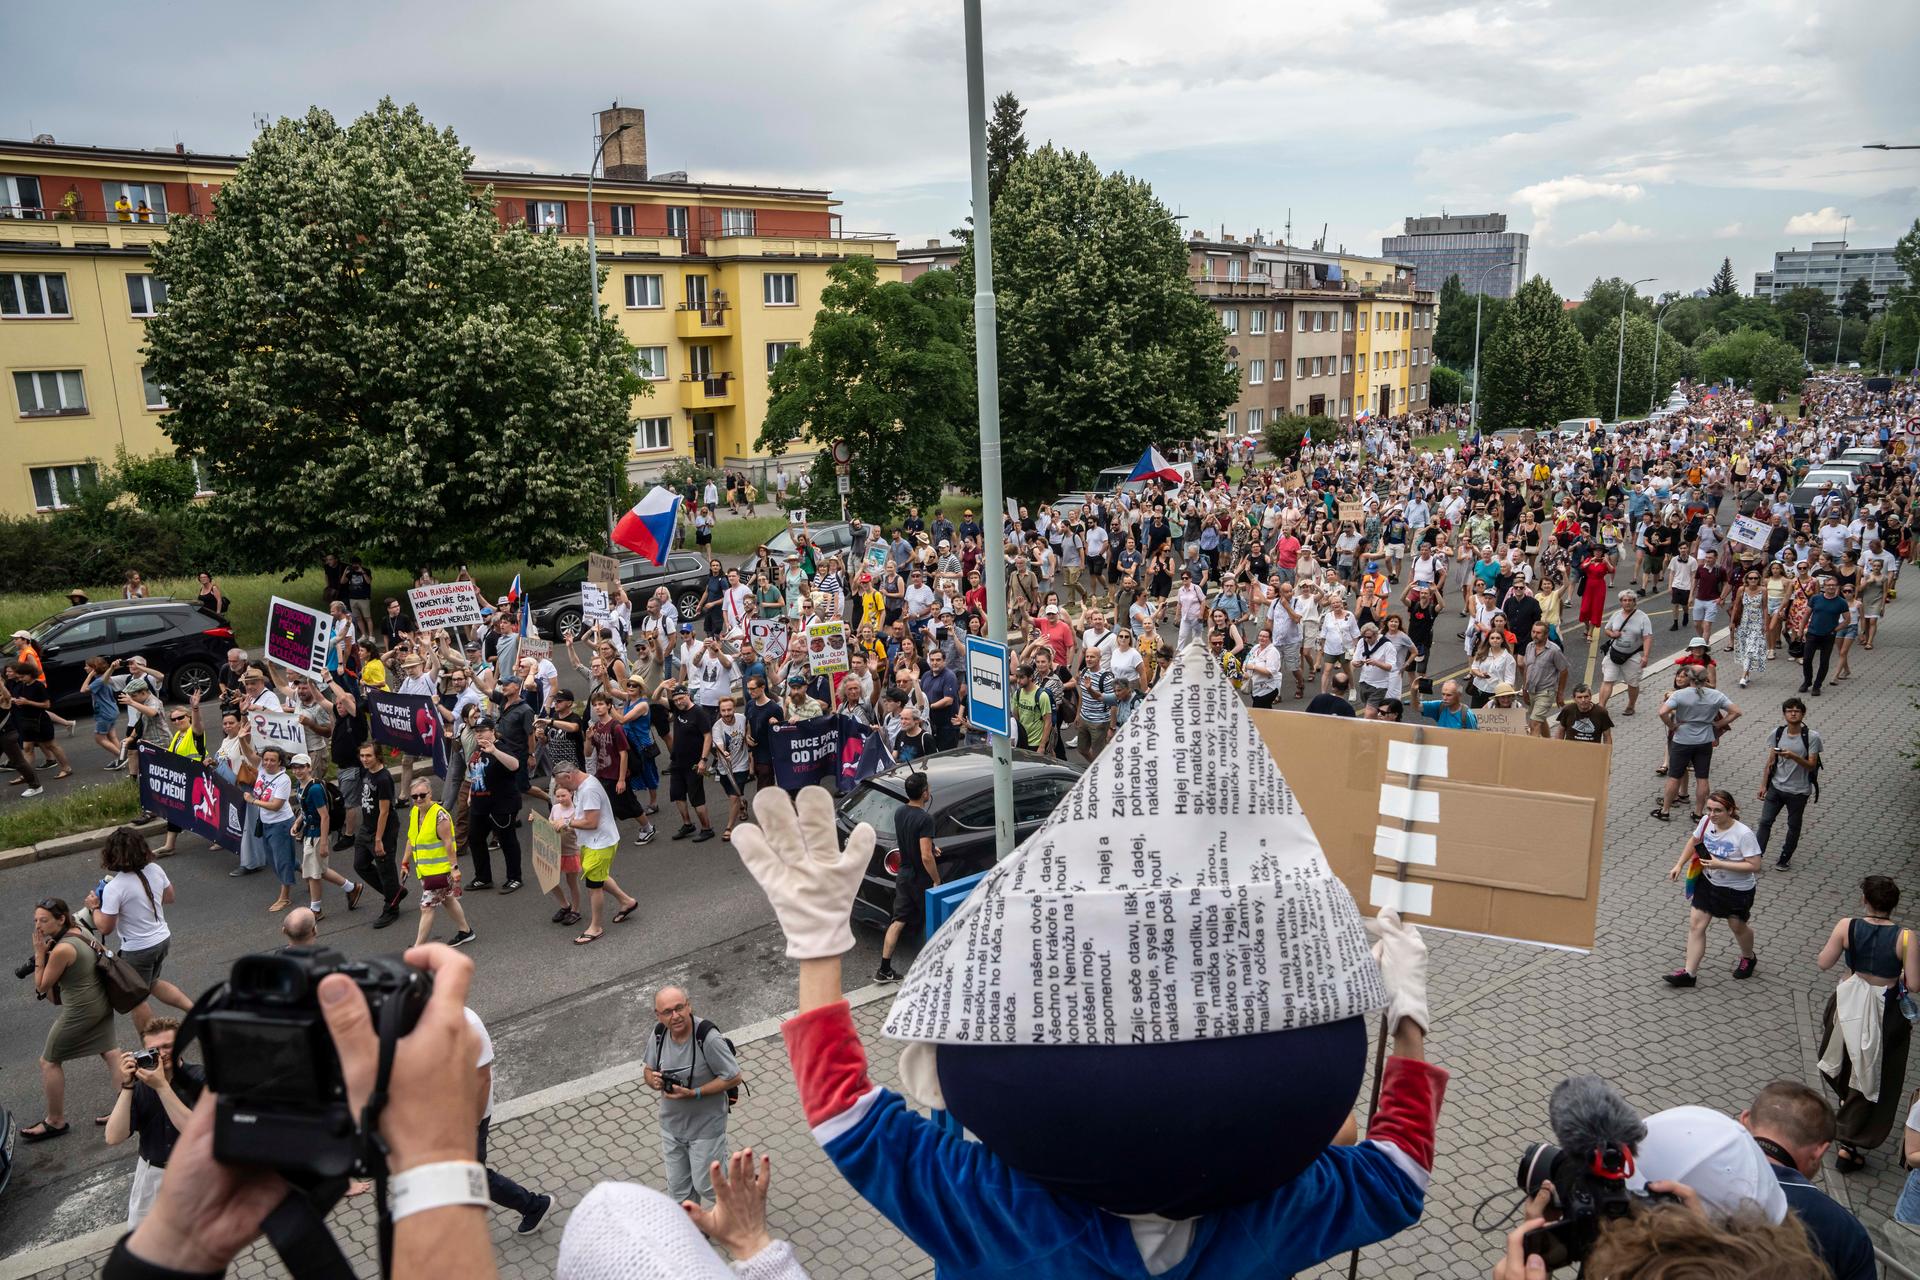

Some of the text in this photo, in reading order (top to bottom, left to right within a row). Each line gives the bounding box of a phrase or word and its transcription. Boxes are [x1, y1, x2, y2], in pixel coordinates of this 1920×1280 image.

[412, 590, 428, 600] LÍDA
[420, 616, 446, 628] PROSÍM
[268, 720, 302, 744] ZLÍN
[376, 702, 410, 718] RUCE PRYČ
[390, 716, 412, 732] MÉDIÍ
[790, 737, 819, 750] RUCE
[792, 750, 810, 764] OD
[1142, 706, 1160, 816] nakládá, myška
[1172, 690, 1189, 814] Hajej můj andílku,
[1188, 684, 1205, 814] spi, matička kolíbá
[1204, 684, 1216, 814] děťátko svý: Hajej,
[1228, 713, 1240, 814] maličký očíčka
[148, 764, 187, 786] RUCE PRYČ
[150, 778, 160, 792] OD
[162, 782, 186, 802] MÉDIÍ
[1112, 746, 1128, 818] Zajíc seče
[1128, 742, 1144, 816] pohrabuje,
[1218, 726, 1230, 815] dadej, malej!
[1246, 750, 1257, 814] Hajej můj
[1265, 764, 1276, 814] děťátko
[1258, 790, 1266, 814] spi,
[1040, 840, 1054, 883] dadej,
[1098, 836, 1113, 884] hajej a
[1130, 834, 1146, 878] dadej,
[1218, 831, 1228, 853] mu
[1030, 894, 1042, 934] dvoře
[1046, 907, 1058, 960] krákoře
[1316, 914, 1331, 960] očíčka
[976, 950, 987, 975] měl
[1030, 938, 1043, 986] našem
[1126, 920, 1141, 964] otavu,
[1161, 928, 1178, 974] myška
[1238, 943, 1253, 986] malej!
[1252, 895, 1270, 1032] maličký očíčka svý.
[1275, 903, 1296, 1029] Hajej můj andílku,
[1286, 896, 1308, 1026] spi, matička kolíbá
[1296, 895, 1320, 1024] děťátko svý: Hajej,
[989, 924, 1004, 1042] potkala ho Káča,
[1049, 964, 1060, 978] to
[1062, 904, 1080, 1044] kohout. Nemůžu na
[1081, 937, 1098, 1044] potěšení moje,
[1128, 968, 1142, 1003] seče
[1144, 900, 1166, 1042] pohrabuje, sysel na
[1189, 910, 1208, 1038] Hajej můj andílku,
[1206, 904, 1226, 1038] spi, matička kolíbá
[1220, 902, 1239, 1036] děťátko svý: Hajej,
[1311, 934, 1331, 1022] dadej, malej!
[900, 1000, 918, 1036] růžky,
[912, 982, 932, 1038] tvarůžky
[924, 982, 942, 1038] tabáček,
[936, 962, 955, 1040] hajdaláček.
[958, 964, 975, 1041] Šel zajíček
[972, 980, 987, 1042] kapsičku
[1004, 992, 1016, 1042] koláča.
[1032, 992, 1044, 1018] tom
[1048, 984, 1062, 1044] všechno
[1098, 950, 1116, 1044] zapomenout.
[1164, 979, 1179, 1041] nakládá,
[1242, 990, 1256, 1034] dadej,
[1327, 982, 1340, 1019] malič
[1032, 1023, 1044, 1043] Na
[1131, 1008, 1148, 1043] Zajíc
